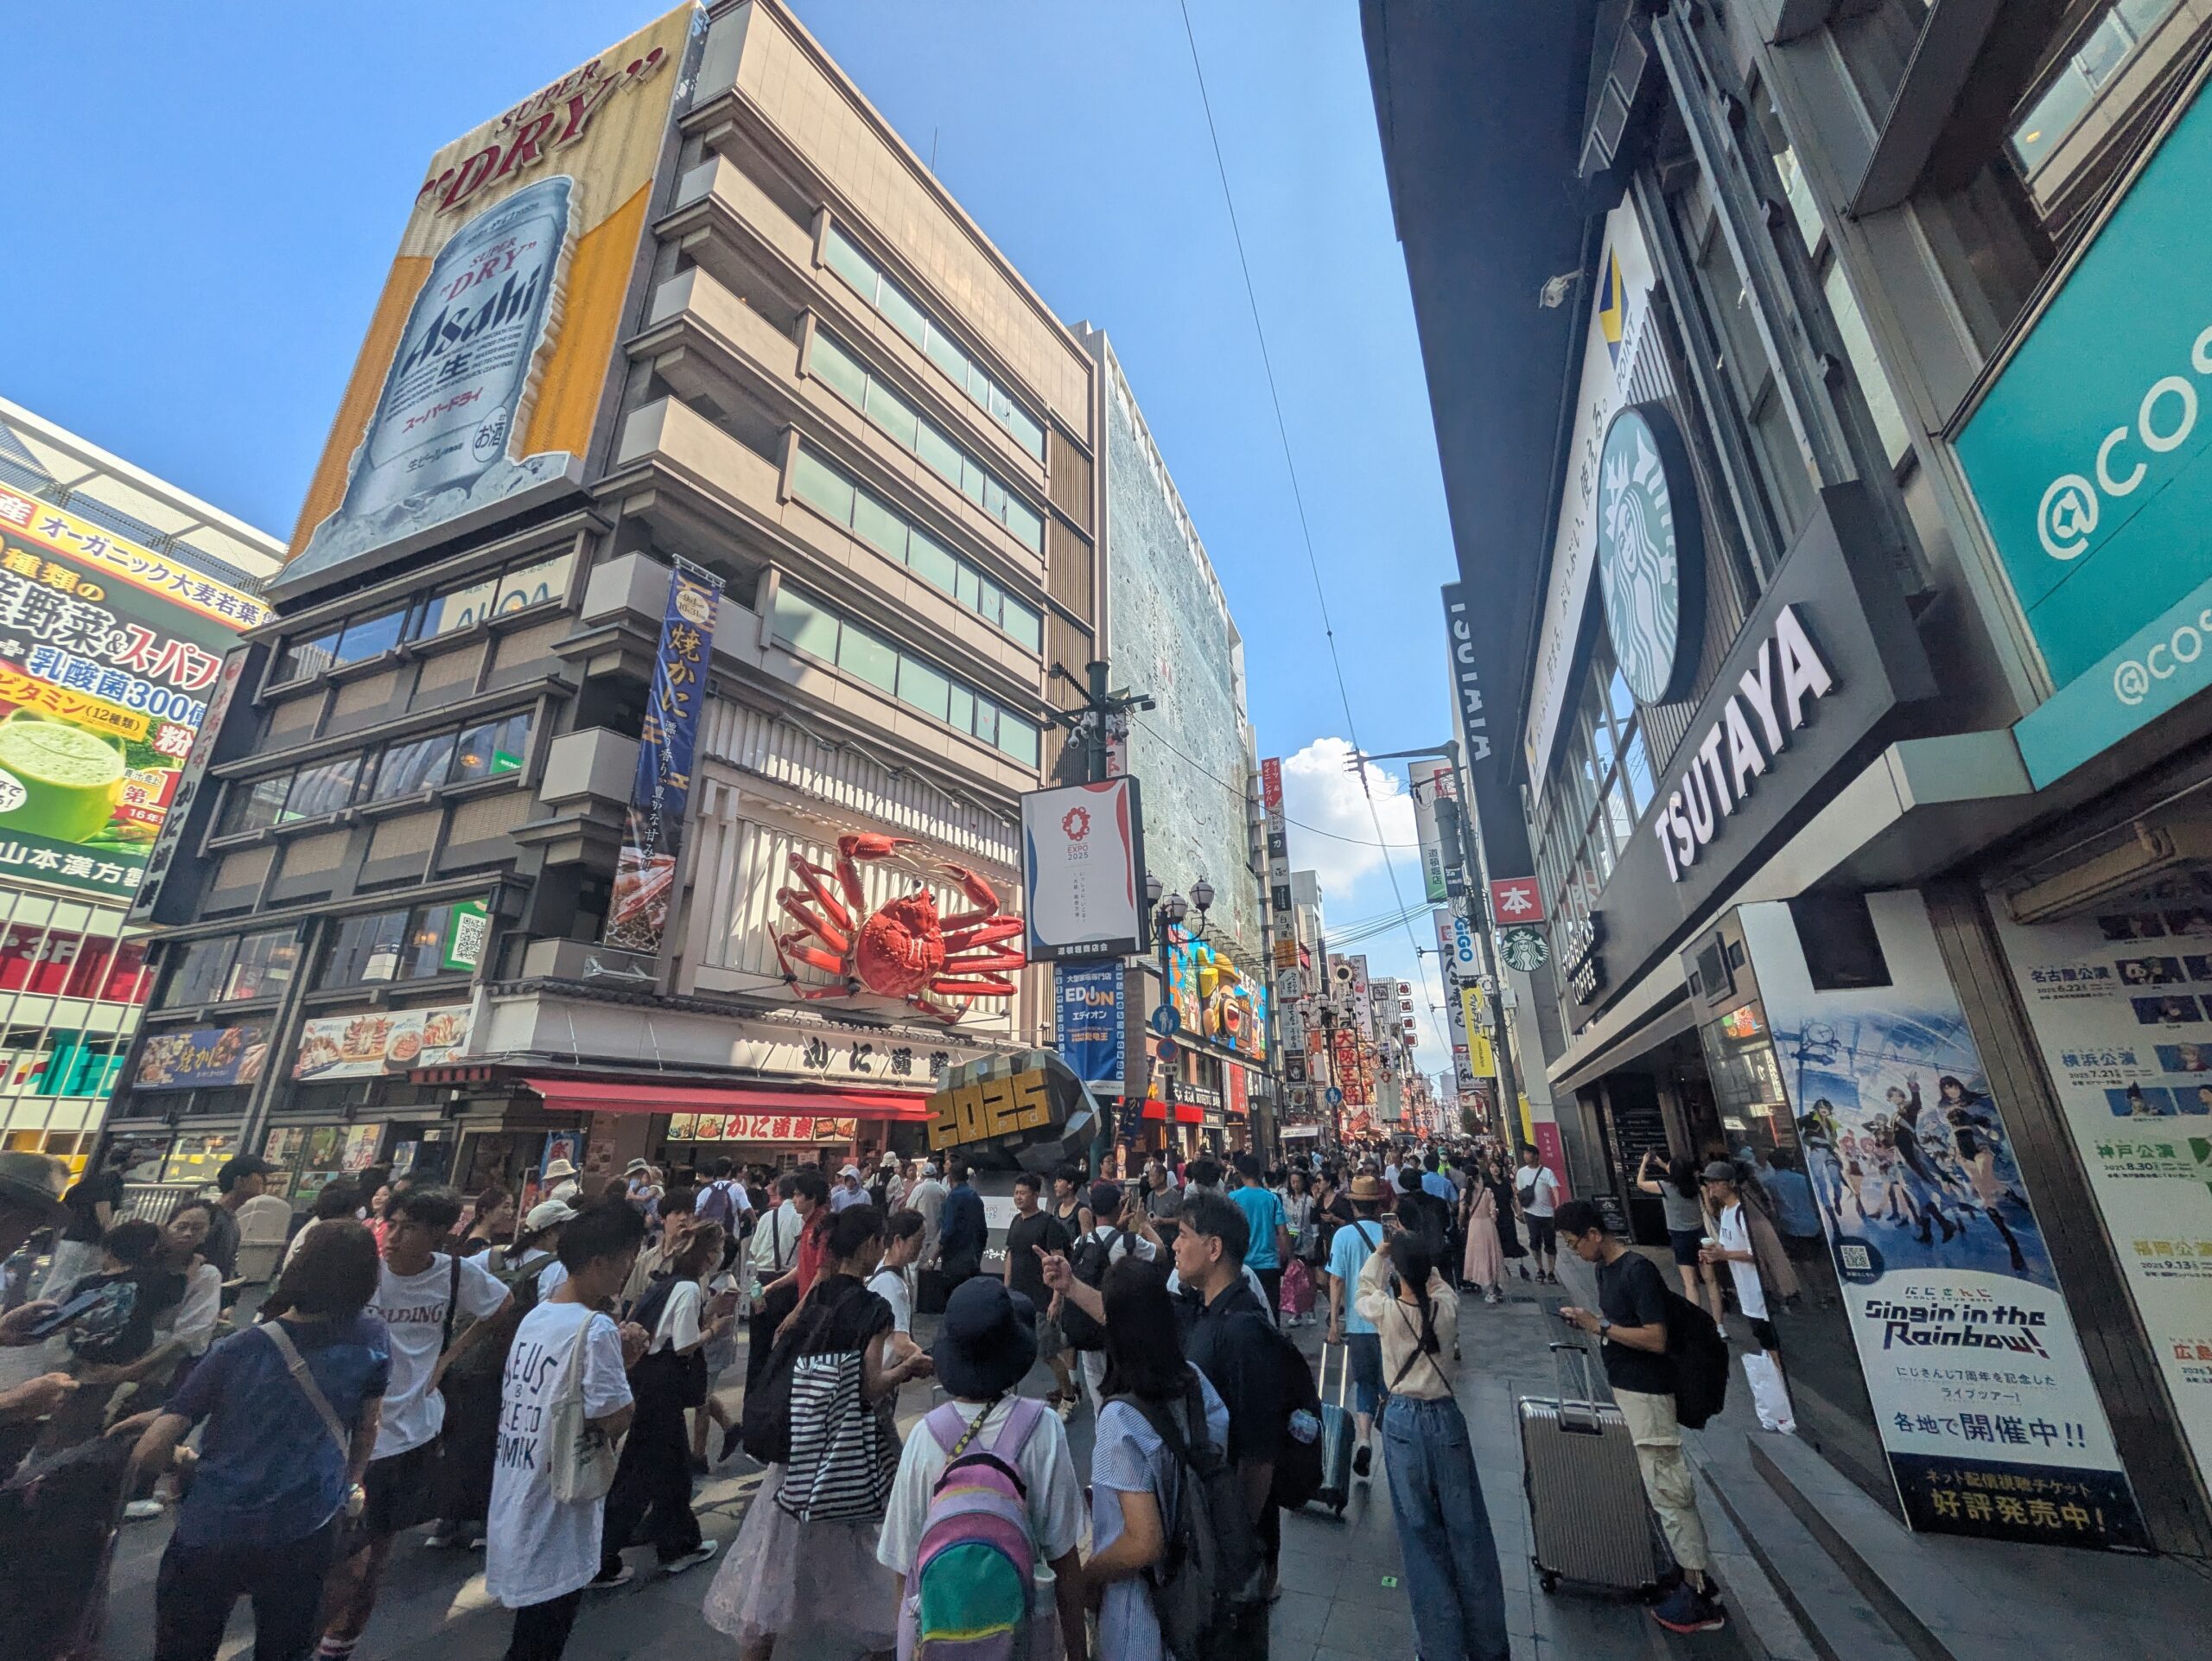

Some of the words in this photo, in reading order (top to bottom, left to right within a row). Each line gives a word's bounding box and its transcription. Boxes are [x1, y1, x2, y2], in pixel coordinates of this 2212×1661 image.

[495, 60, 602, 137] SUPER
[470, 237, 518, 267] SUPER
[400, 264, 542, 379] Asahi
[436, 353, 473, 383] 生
[1616, 312, 1635, 394] POINT
[403, 387, 484, 432] スーパードライ
[0, 534, 105, 601] 種類の
[661, 622, 703, 718] 焼かに
[1655, 604, 1832, 882] TSUTAYA
[1067, 844, 1089, 854] EXPO
[1067, 851, 1089, 861] 2025
[1427, 849, 1442, 885] 道頓堀店
[1499, 887, 1533, 914] 本
[1057, 943, 1109, 957] 道頓堀商店会
[1453, 918, 1473, 963] GiGO
[1065, 985, 1115, 1007] EDION
[1572, 957, 1597, 1006] COFFEE
[1072, 1010, 1108, 1021] エディオン
[726, 1115, 813, 1139] かに道楽
[926, 1069, 1051, 1151] 2025
[1963, 1304, 1987, 1324] in
[1993, 1306, 2047, 1327] the
[1884, 1321, 2051, 1360] Rainbow!
[1894, 1411, 2086, 1448] 各地で開催中!!
[1931, 1487, 2106, 1533] 好評発売中!
